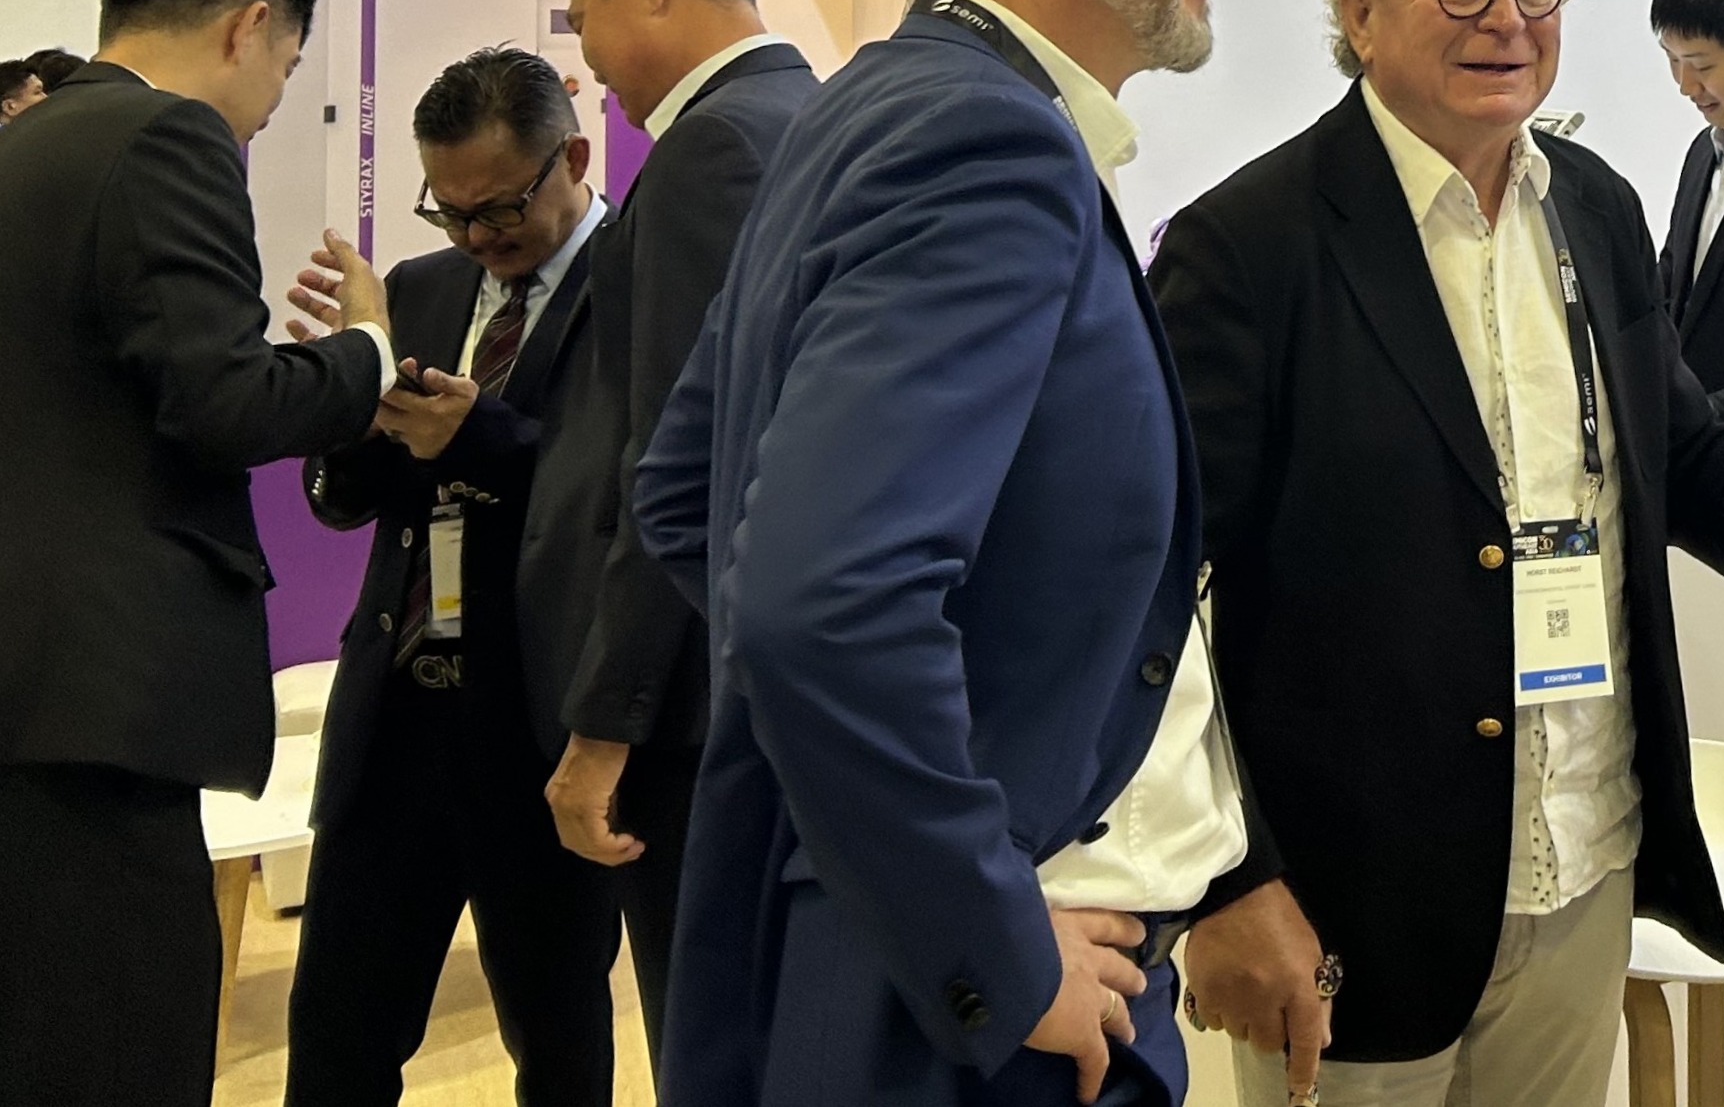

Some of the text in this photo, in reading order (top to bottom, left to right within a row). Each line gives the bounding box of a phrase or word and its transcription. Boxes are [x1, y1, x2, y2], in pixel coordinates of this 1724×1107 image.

[949, 3, 989, 31] semi
[360, 83, 375, 219] STYRAX INLINE
[1582, 377, 1595, 414] semi
